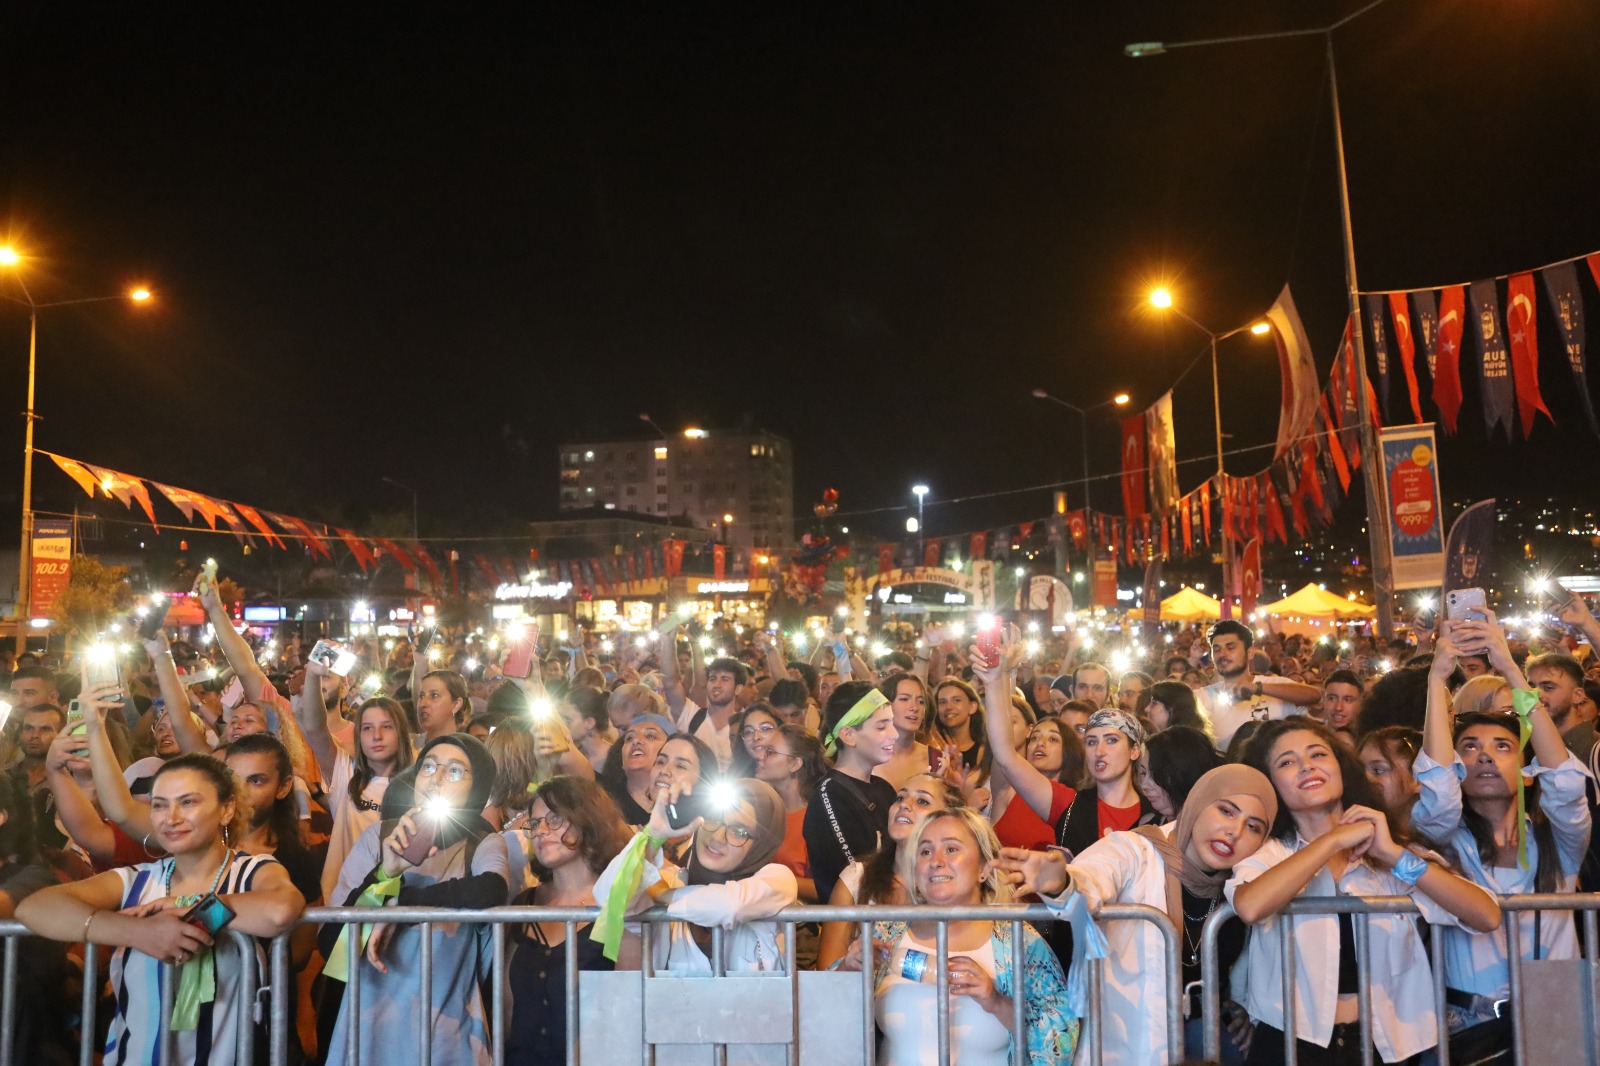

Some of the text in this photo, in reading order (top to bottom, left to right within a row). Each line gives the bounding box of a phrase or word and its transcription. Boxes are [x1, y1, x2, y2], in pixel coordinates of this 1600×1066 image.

[1401, 514, 1422, 526] 999
[35, 562, 68, 575] 100.9
[821, 792, 846, 844] DSQUARED2
